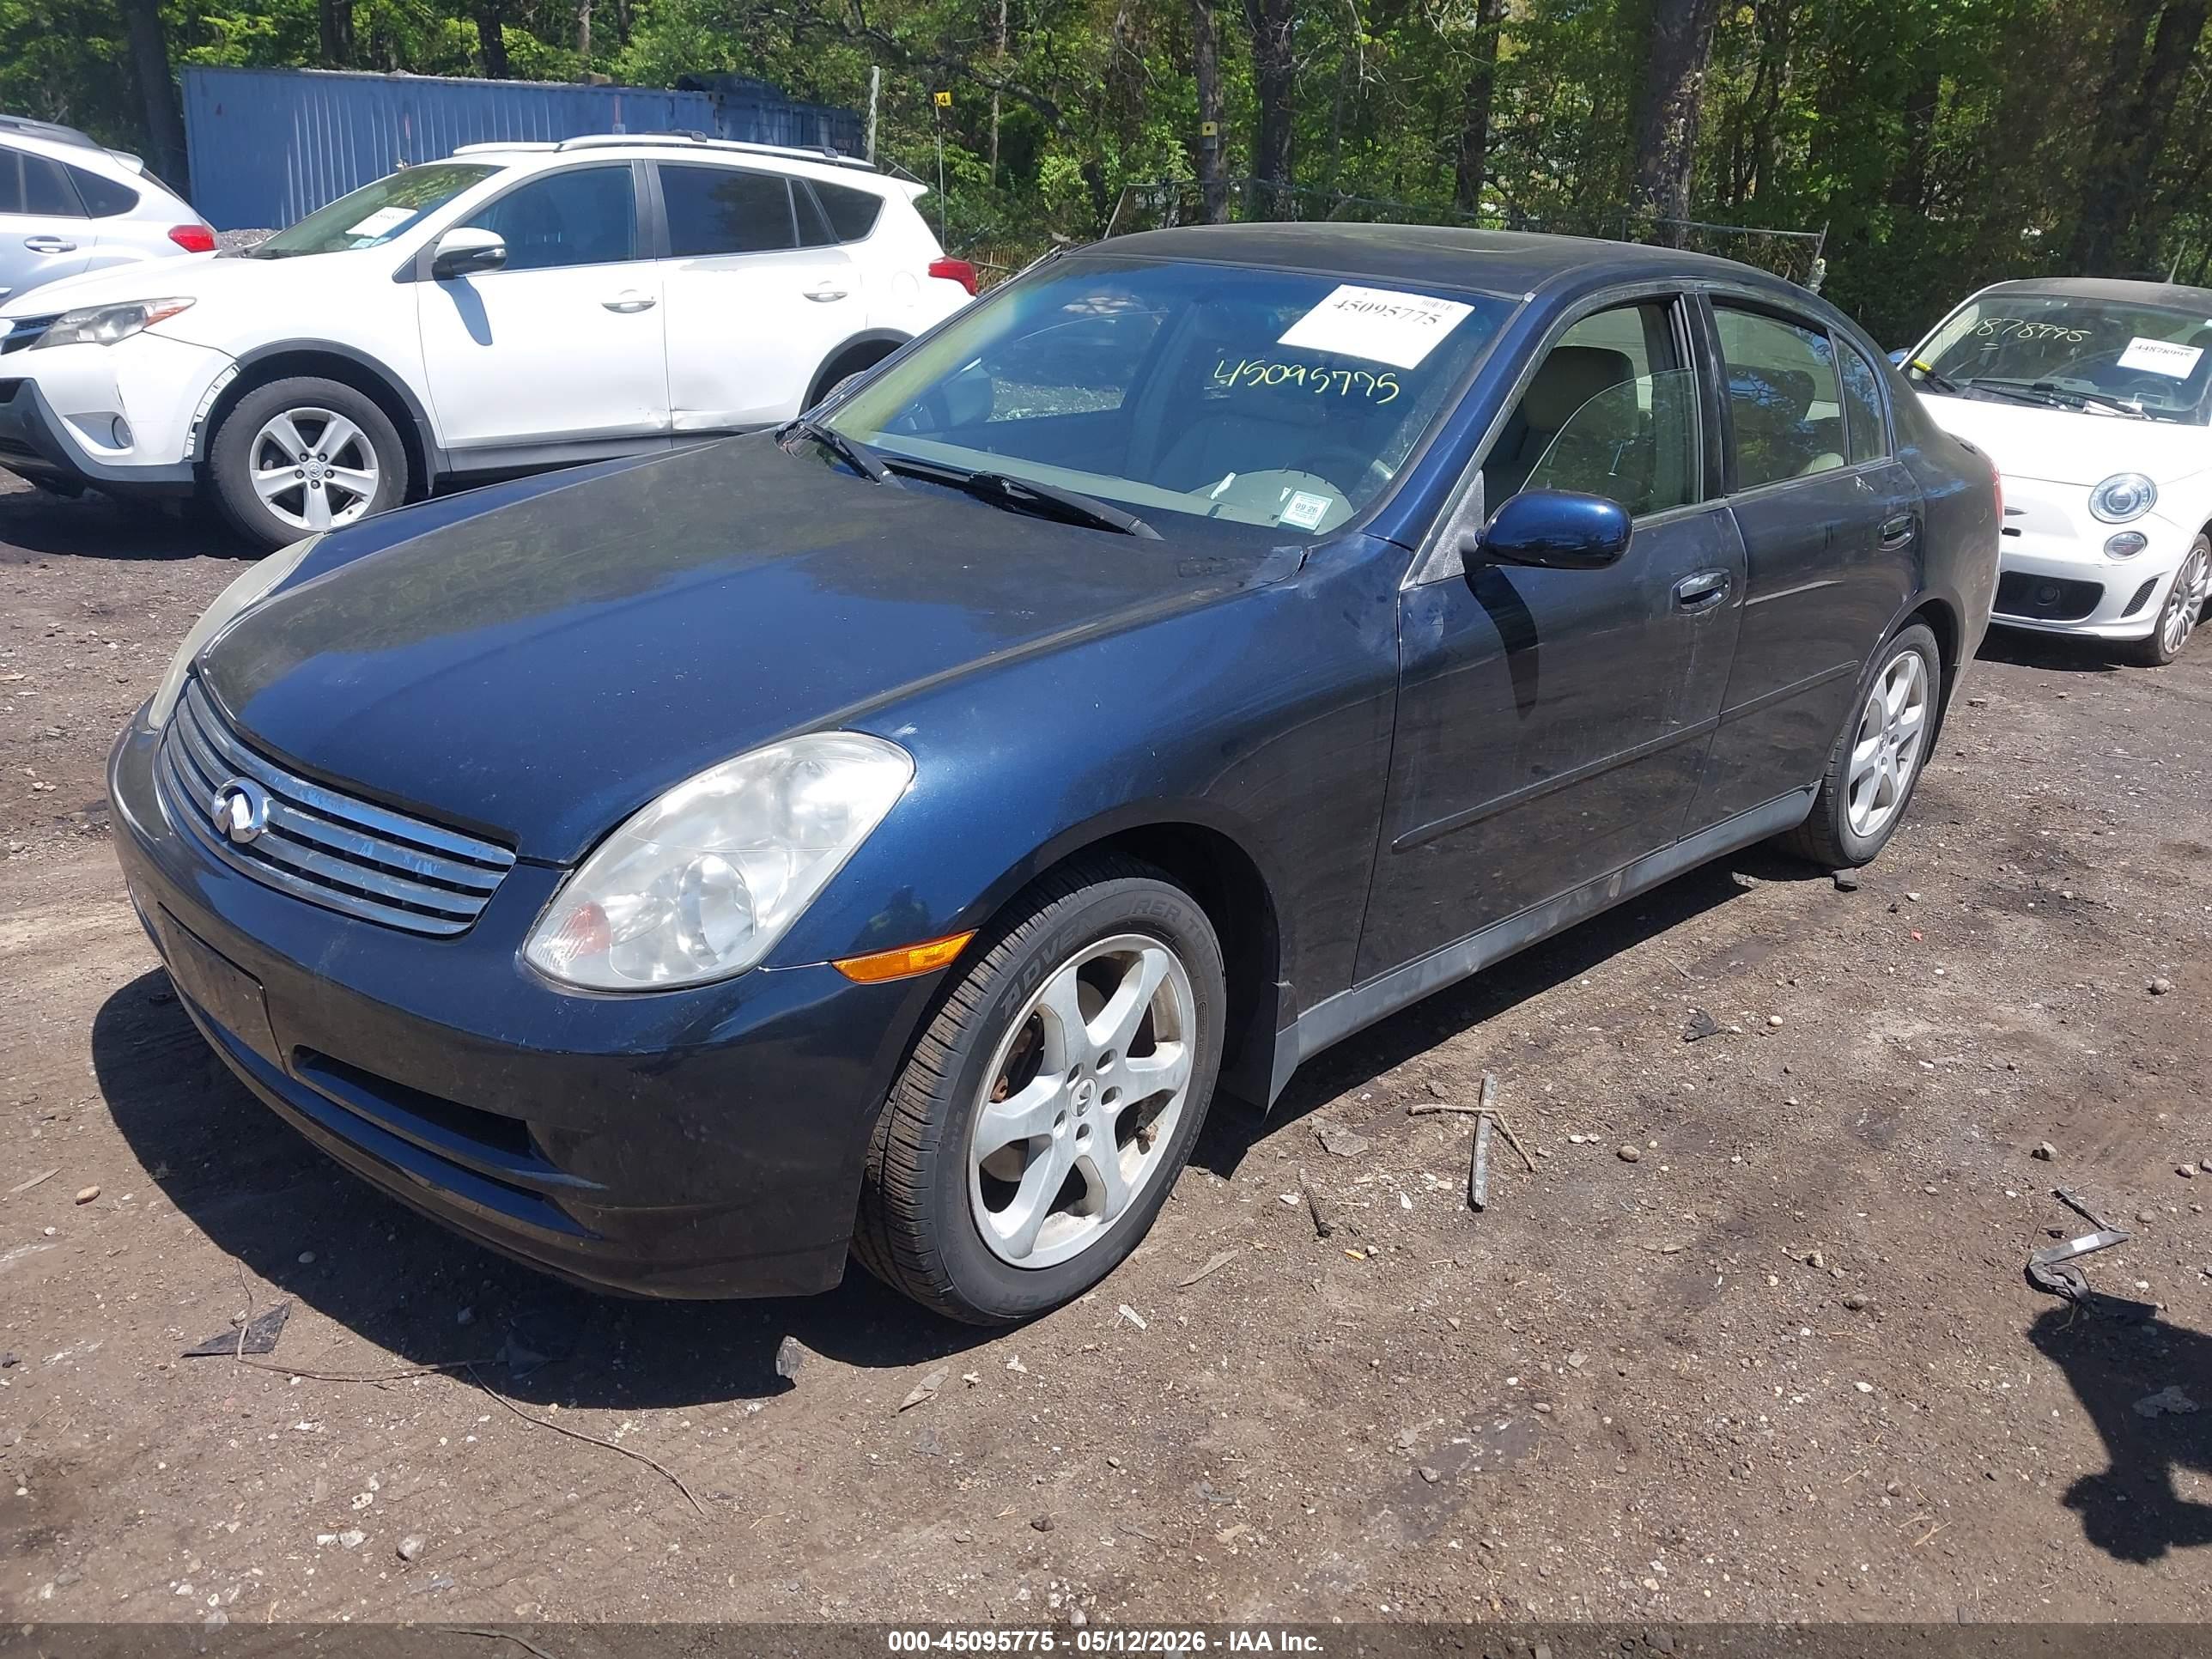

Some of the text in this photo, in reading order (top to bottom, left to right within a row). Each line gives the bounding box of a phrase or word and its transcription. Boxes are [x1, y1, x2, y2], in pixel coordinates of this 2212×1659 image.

[1333, 299, 1442, 325] 45095775
[1213, 359, 1400, 404] 45095775
[1000, 899, 1182, 1018] ADVENURER
